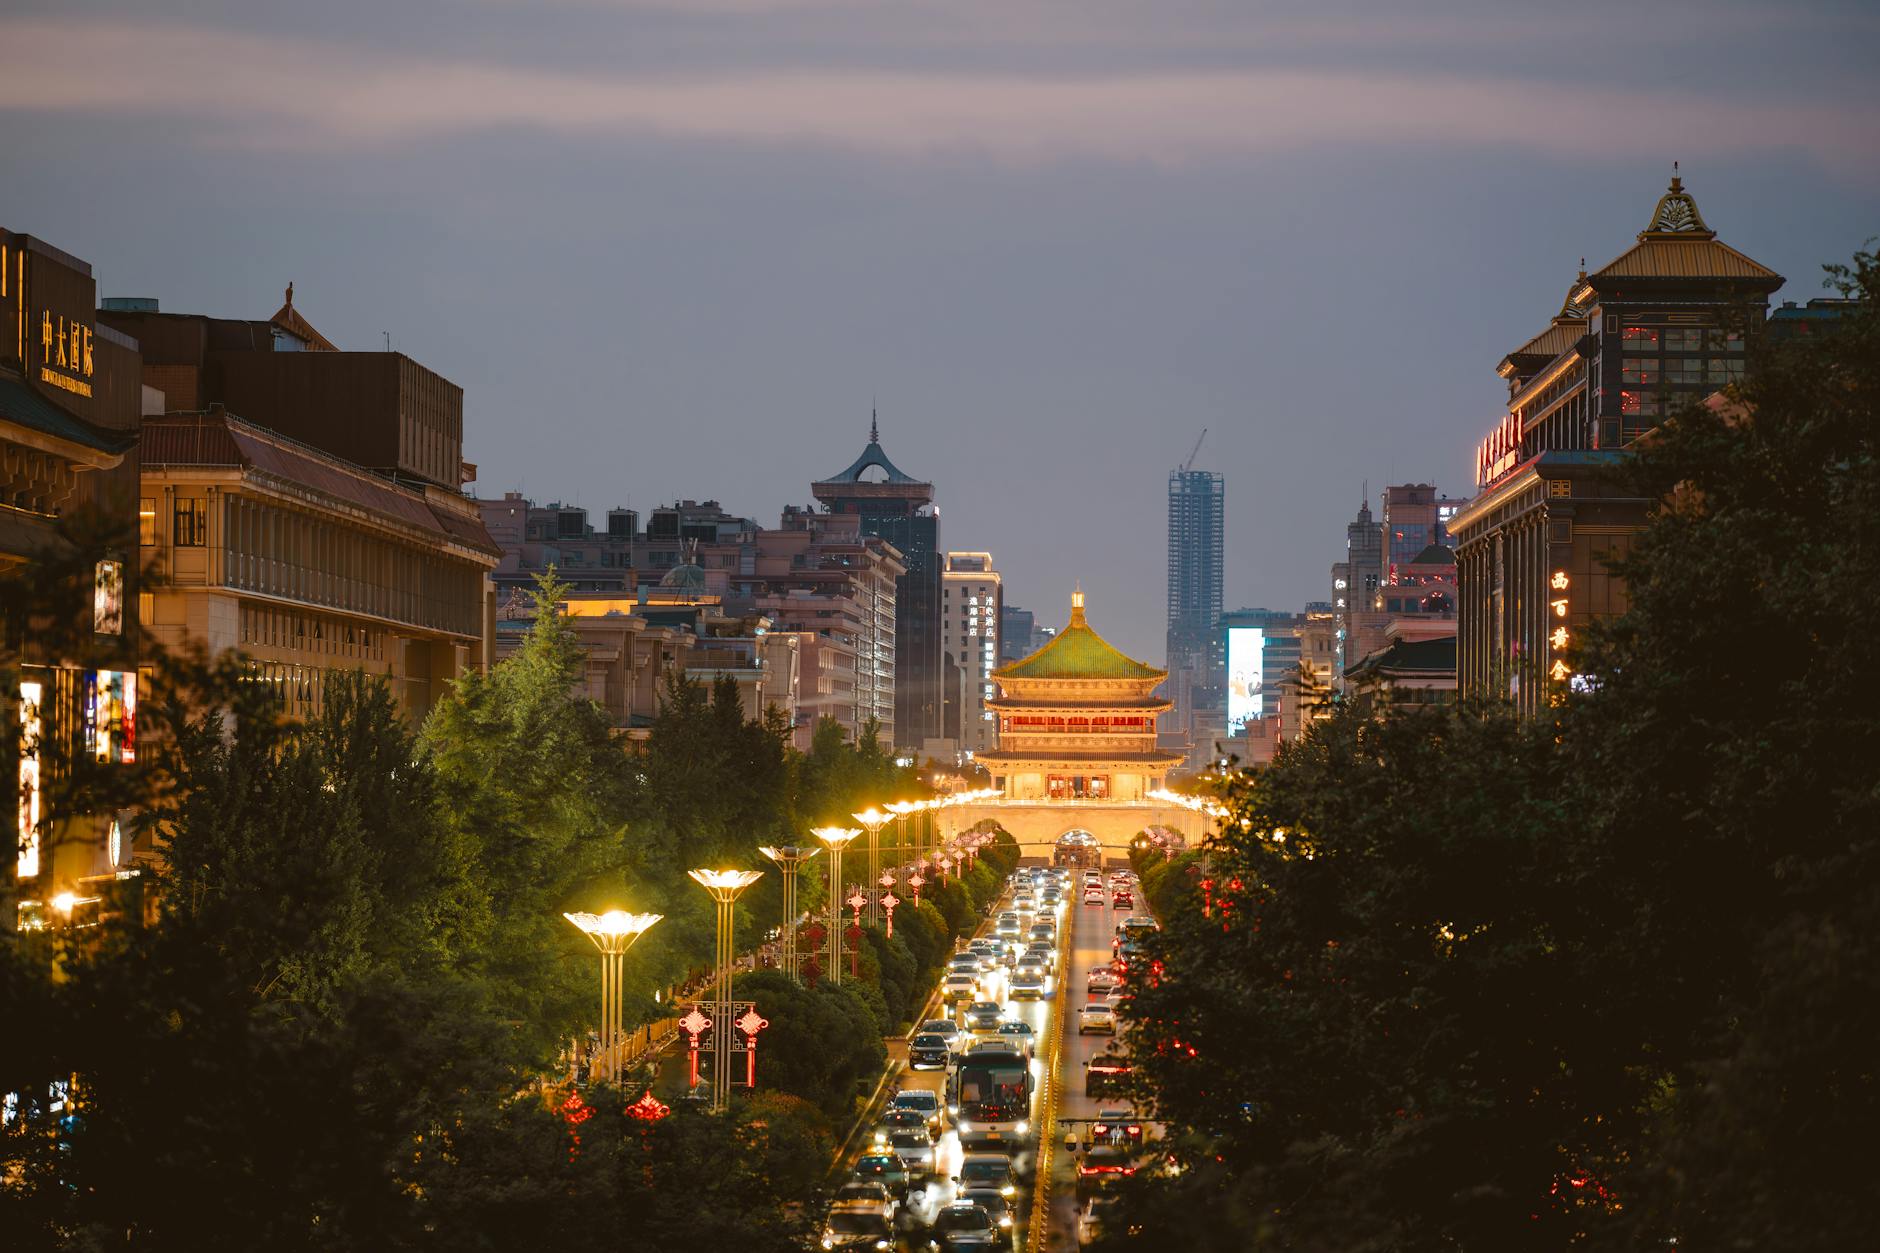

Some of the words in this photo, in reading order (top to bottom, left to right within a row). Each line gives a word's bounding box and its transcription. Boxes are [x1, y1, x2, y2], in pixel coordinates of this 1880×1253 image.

[41, 310, 94, 378] 中大国际
[1550, 571, 1571, 743] 西百黄金
